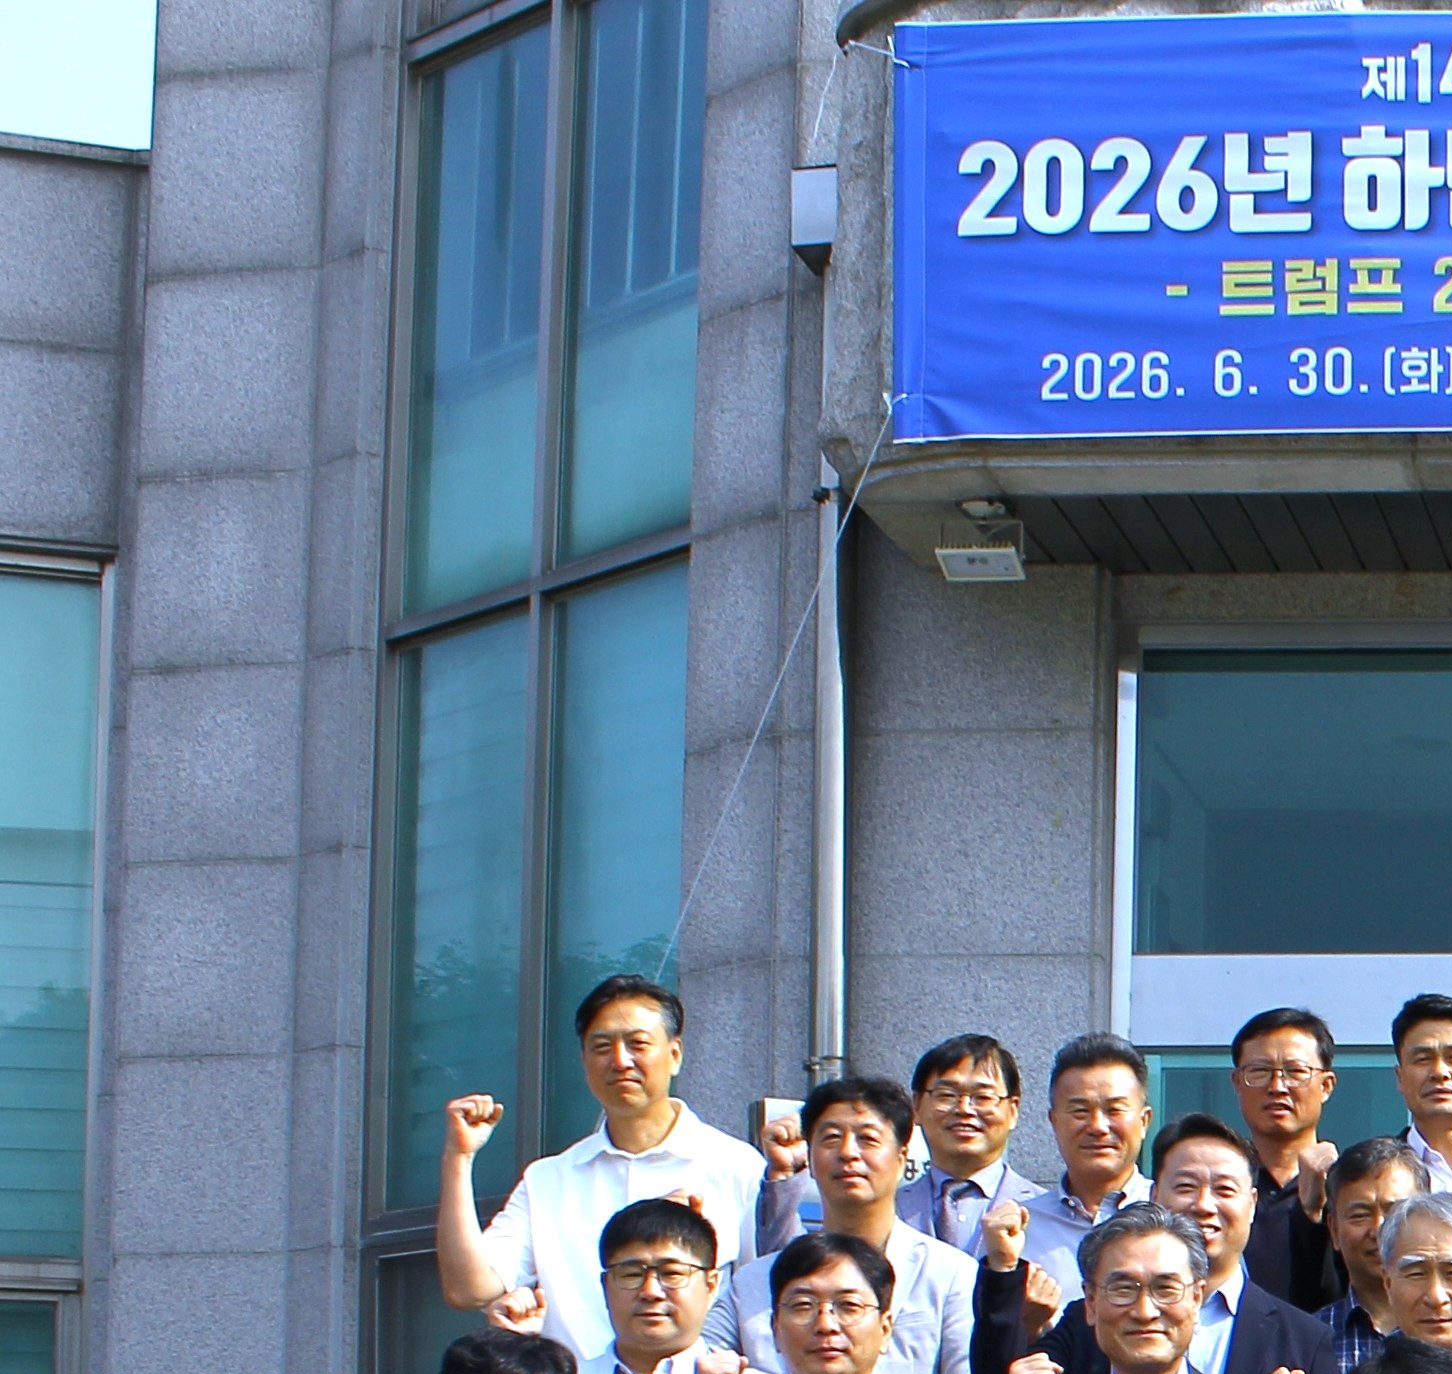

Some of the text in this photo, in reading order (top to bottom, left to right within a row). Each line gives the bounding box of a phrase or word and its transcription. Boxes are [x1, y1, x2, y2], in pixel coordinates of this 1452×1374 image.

[959, 133, 1312, 236] 2026년
[1221, 259, 1403, 315] 트럼프
[1043, 352, 1185, 400] 2026.
[1216, 351, 1258, 396] 6.
